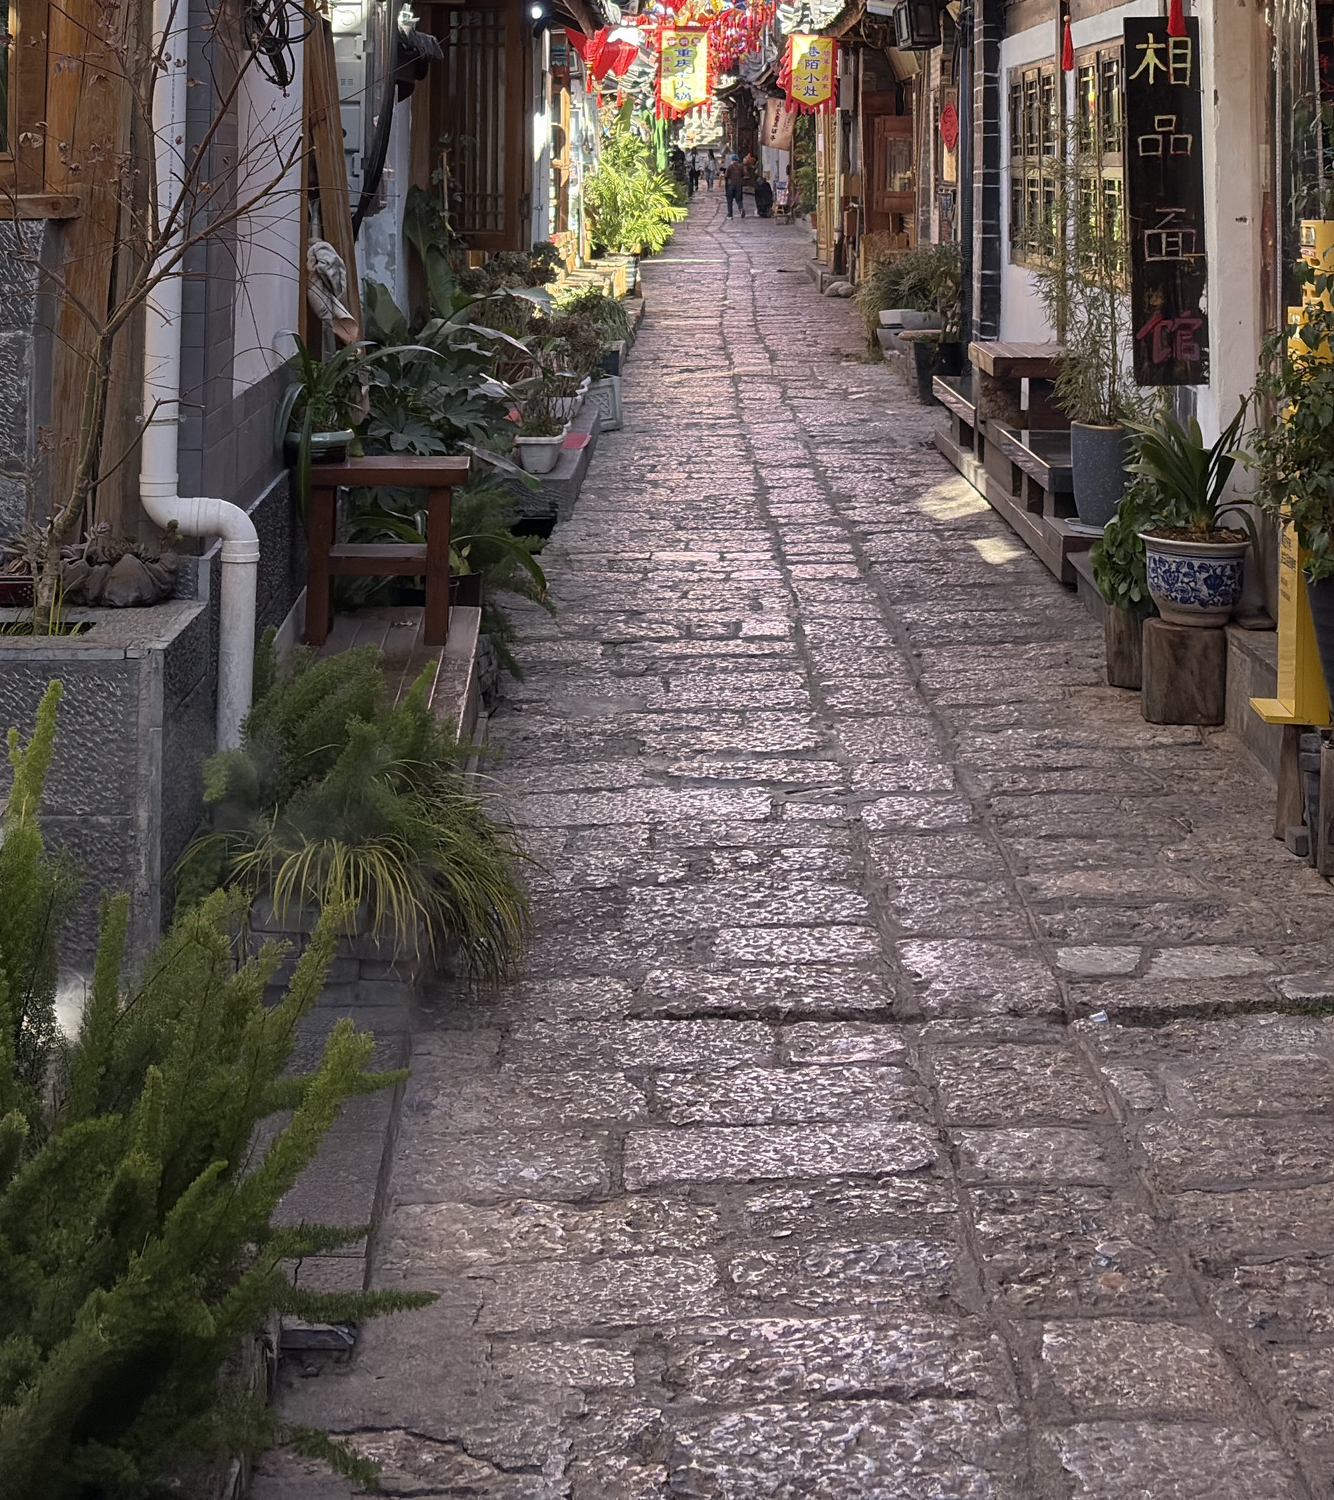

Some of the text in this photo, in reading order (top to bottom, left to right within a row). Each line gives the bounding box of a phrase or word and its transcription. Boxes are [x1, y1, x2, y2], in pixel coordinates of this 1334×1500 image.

[803, 45, 821, 97] 巷陌小灶
[1128, 32, 1203, 366] 相品面馆
